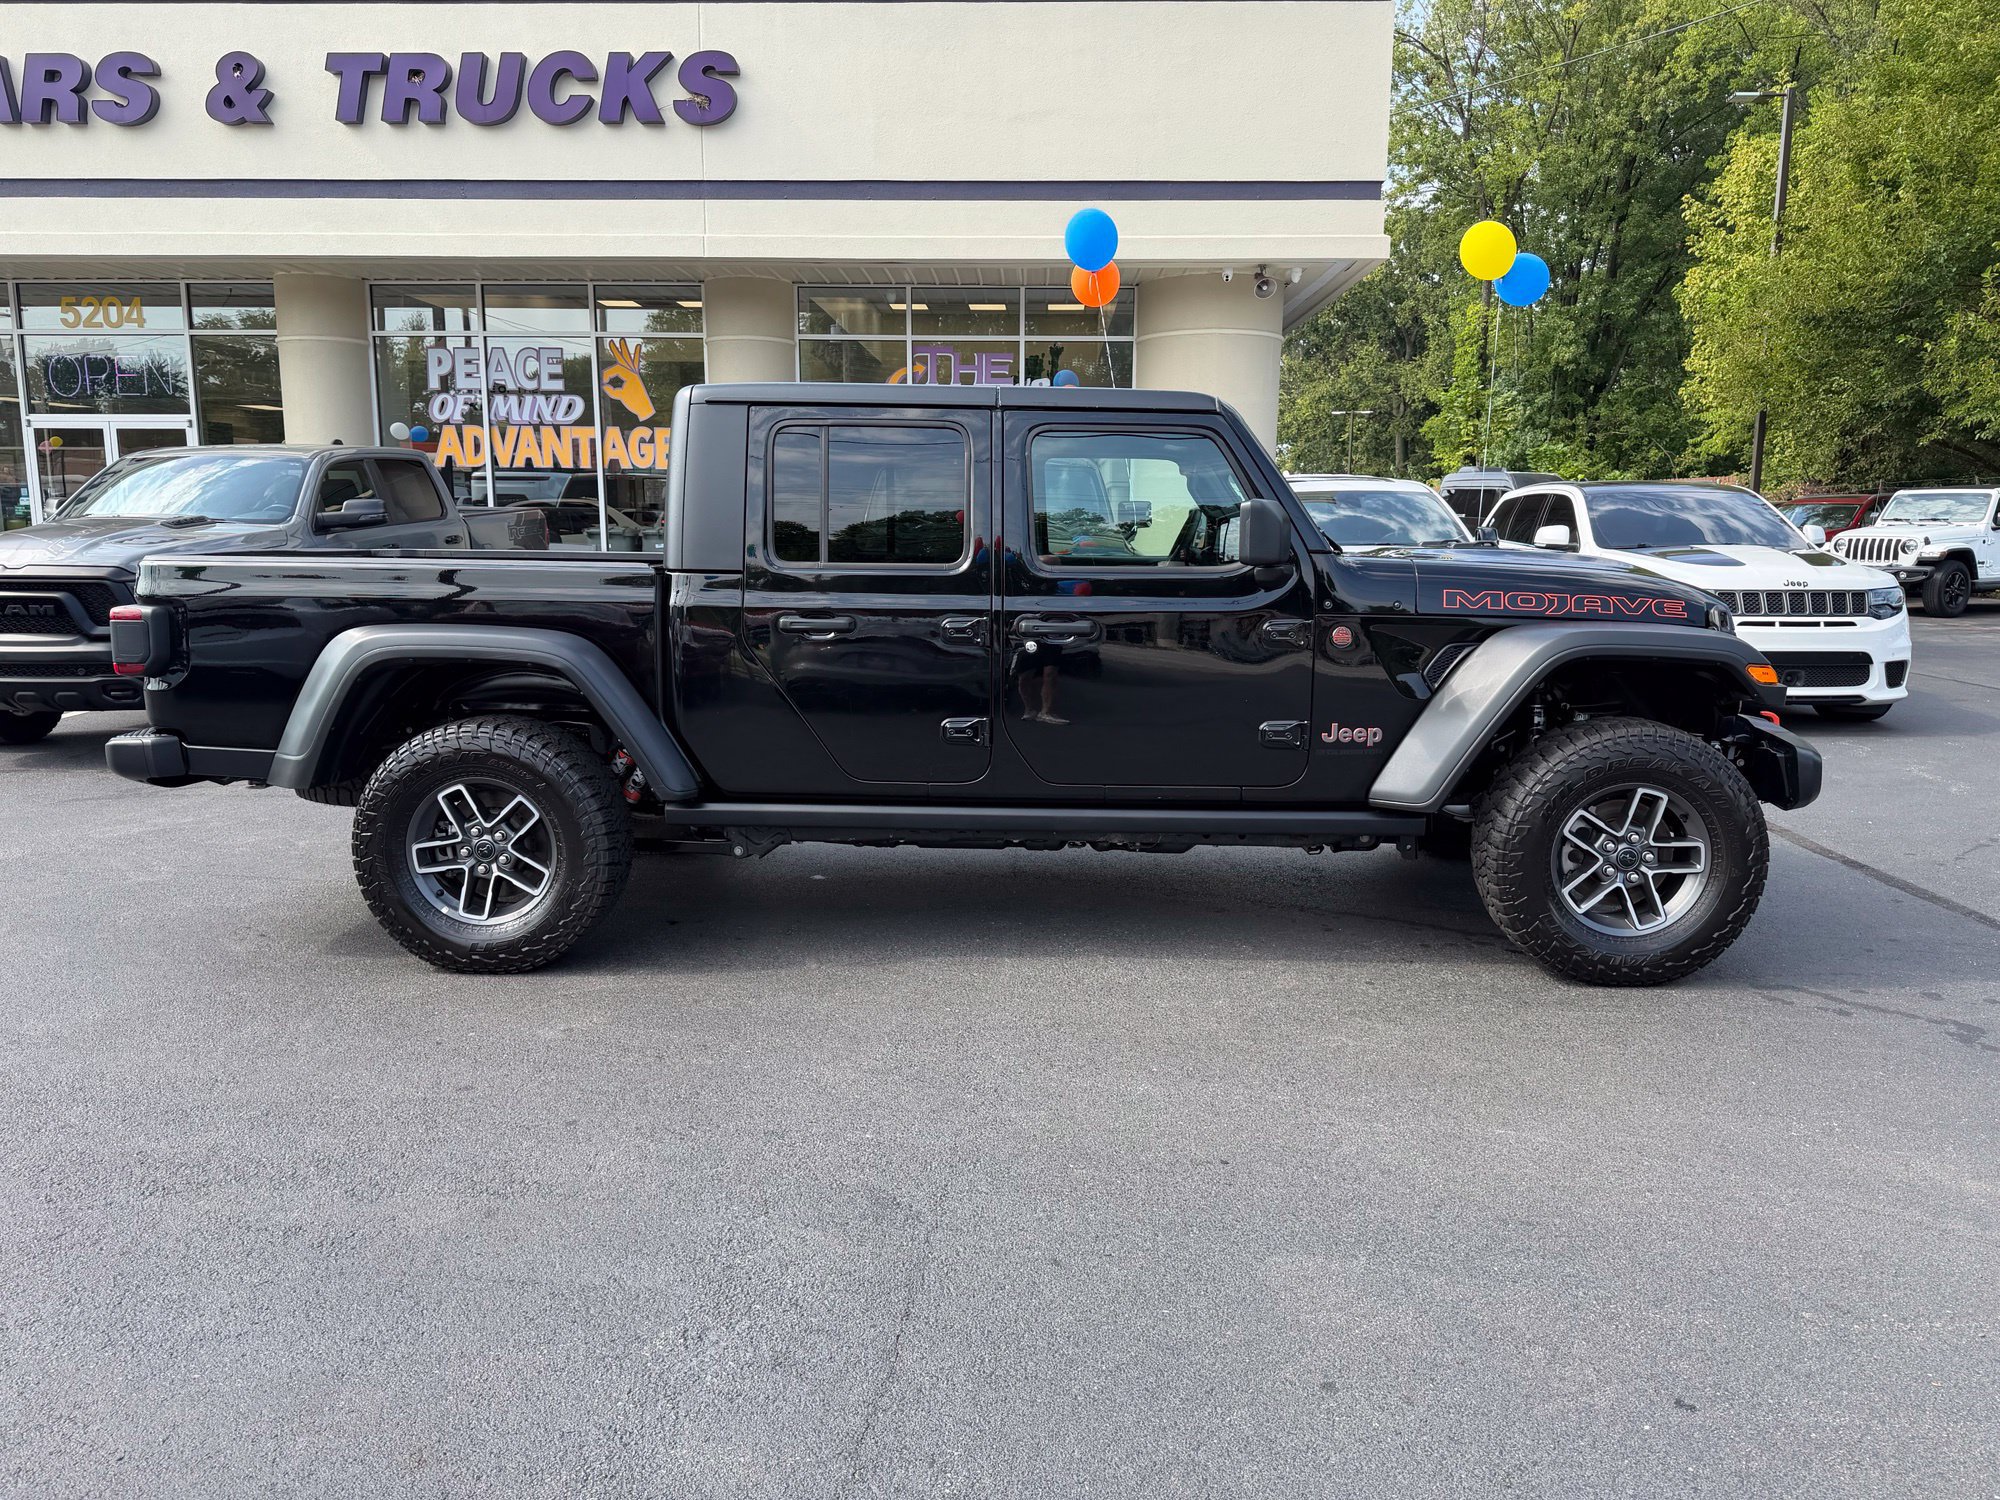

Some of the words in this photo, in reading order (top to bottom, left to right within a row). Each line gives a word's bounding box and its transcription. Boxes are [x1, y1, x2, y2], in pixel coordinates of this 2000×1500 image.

[205, 50, 275, 126] &
[325, 50, 741, 126] TRUCKS
[60, 296, 146, 328] 5204
[49, 355, 174, 397] OPEN
[426, 346, 565, 391] PEACE
[912, 345, 1014, 386] THE
[428, 392, 476, 424] OF
[490, 393, 586, 424] MIND
[434, 424, 672, 469] ADVANTAGE
[1783, 579, 1809, 588] Jeep
[1443, 589, 1688, 618] MOJAVE
[1321, 722, 1383, 747] Jeep
